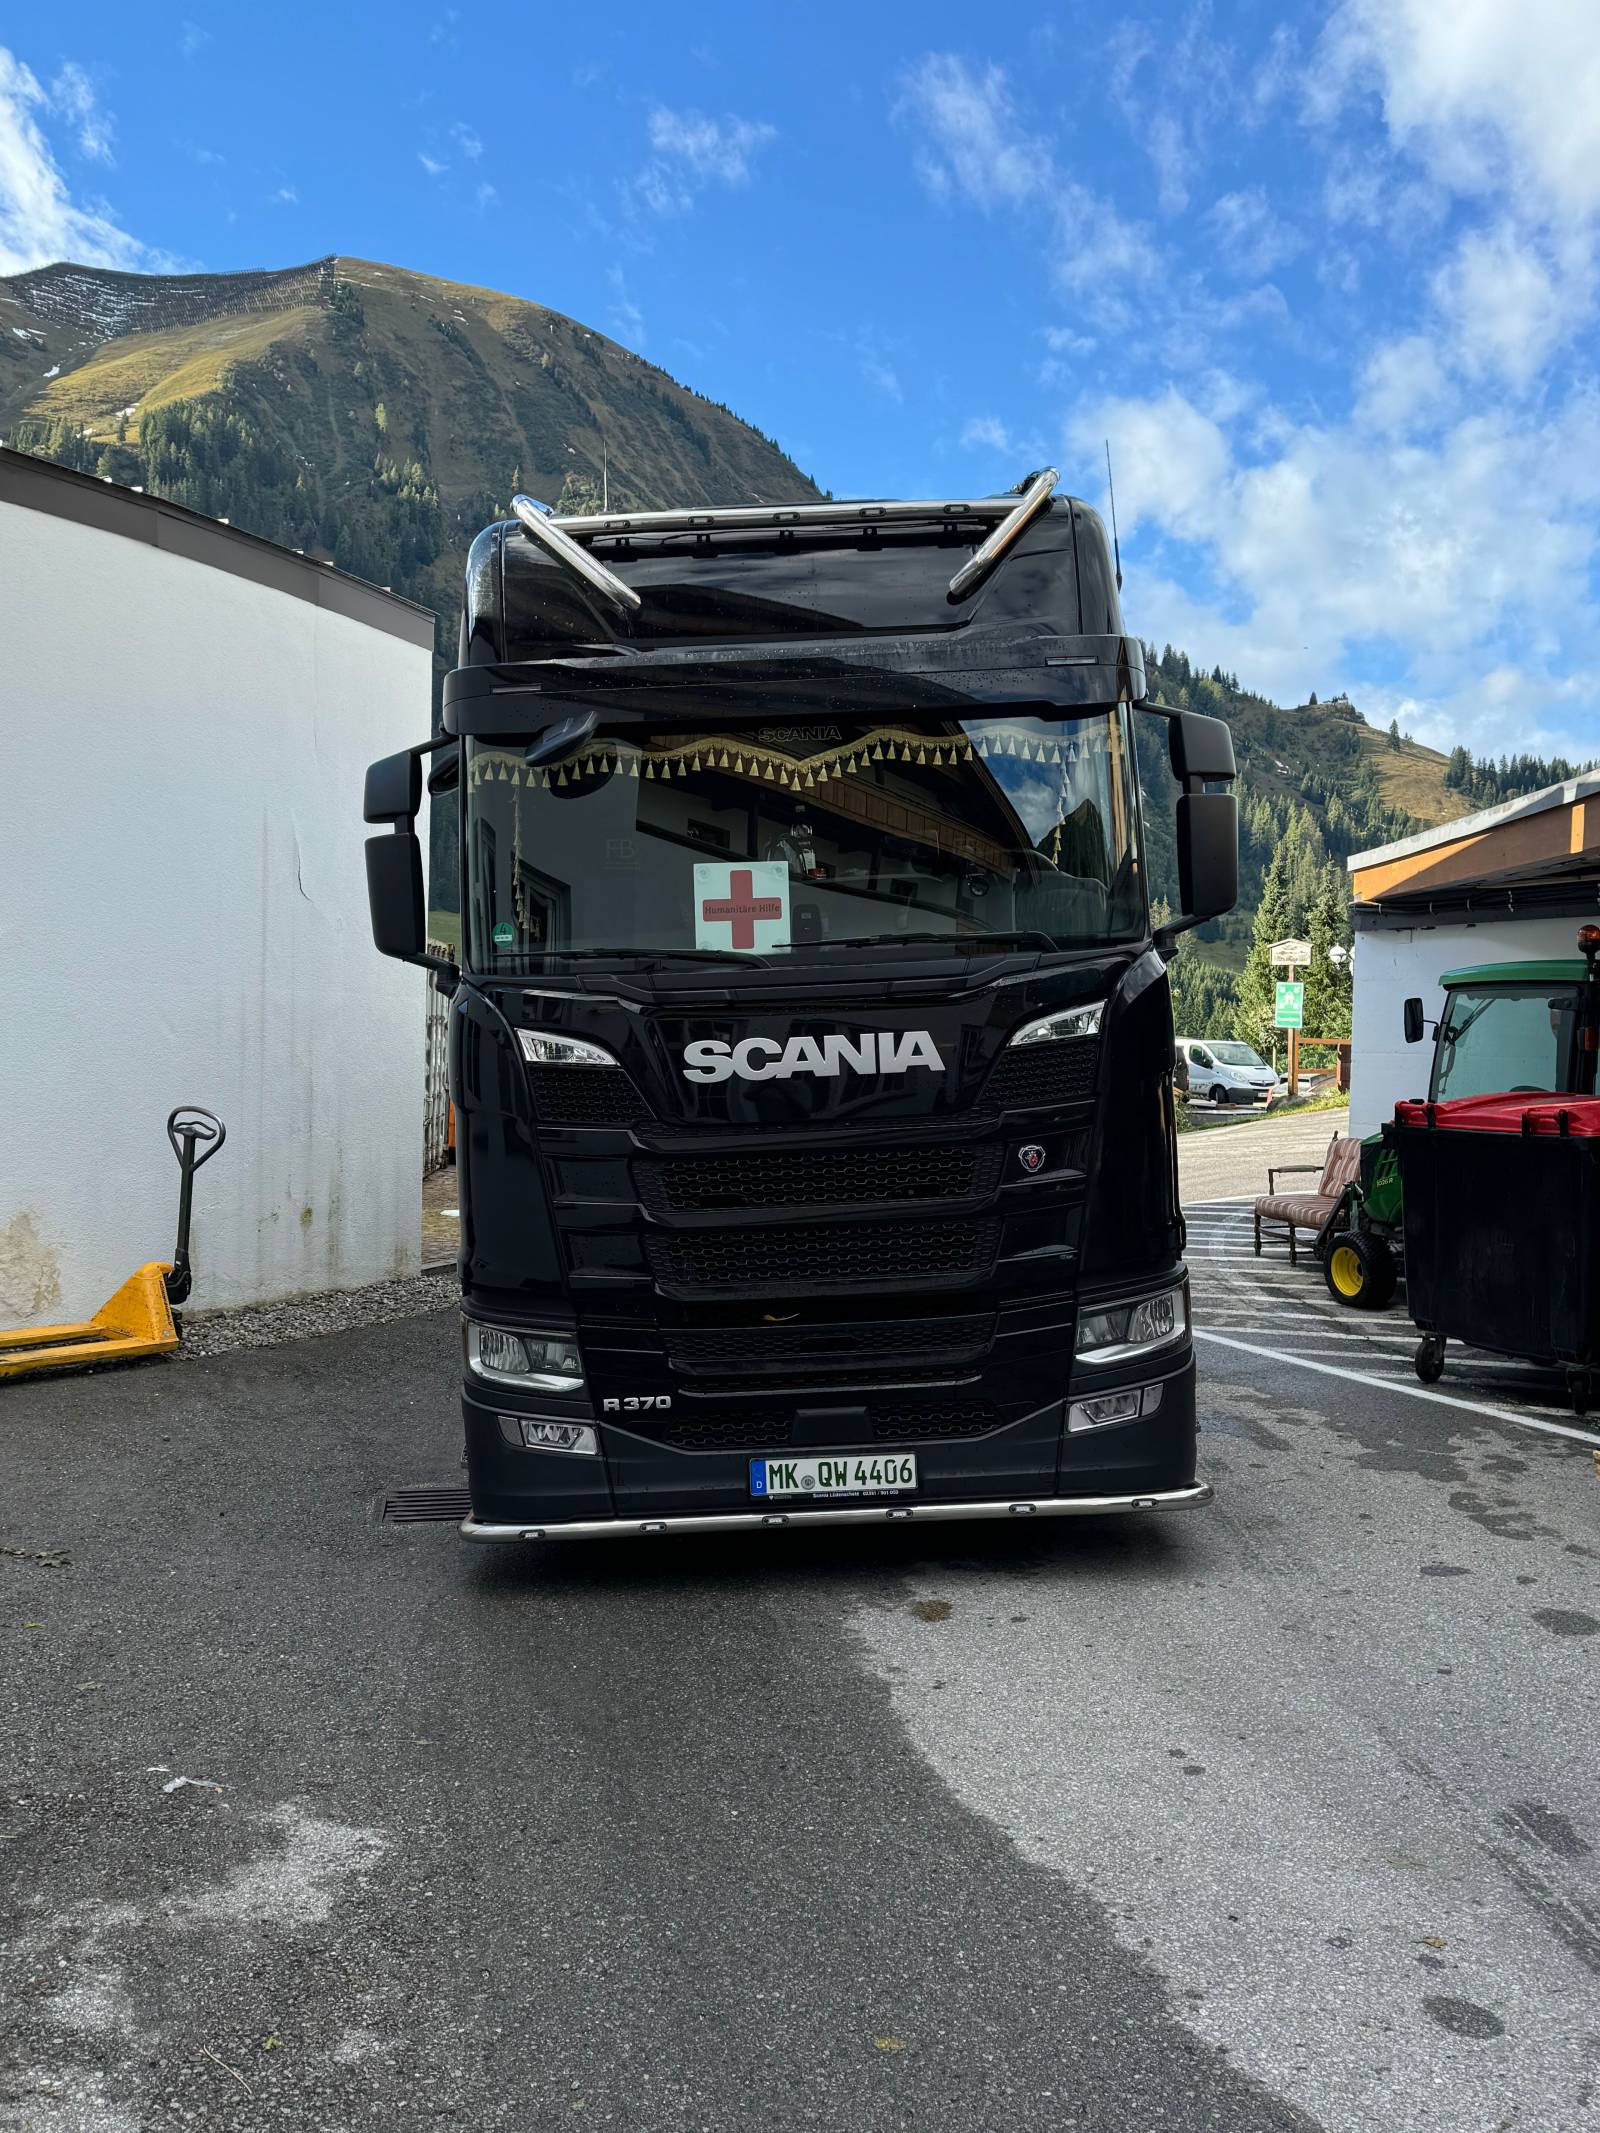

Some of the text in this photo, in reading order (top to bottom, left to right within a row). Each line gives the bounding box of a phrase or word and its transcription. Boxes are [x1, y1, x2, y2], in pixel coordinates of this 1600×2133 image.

[758, 725, 842, 743] SCANIA
[704, 902, 781, 915] Humanitäre Hilfe
[499, 923, 506, 935] 4
[682, 1030, 947, 1084] SCANIA
[603, 1395, 672, 1412] R 370
[768, 1458, 913, 1490] MK QW 4406
[756, 1481, 763, 1489] D
